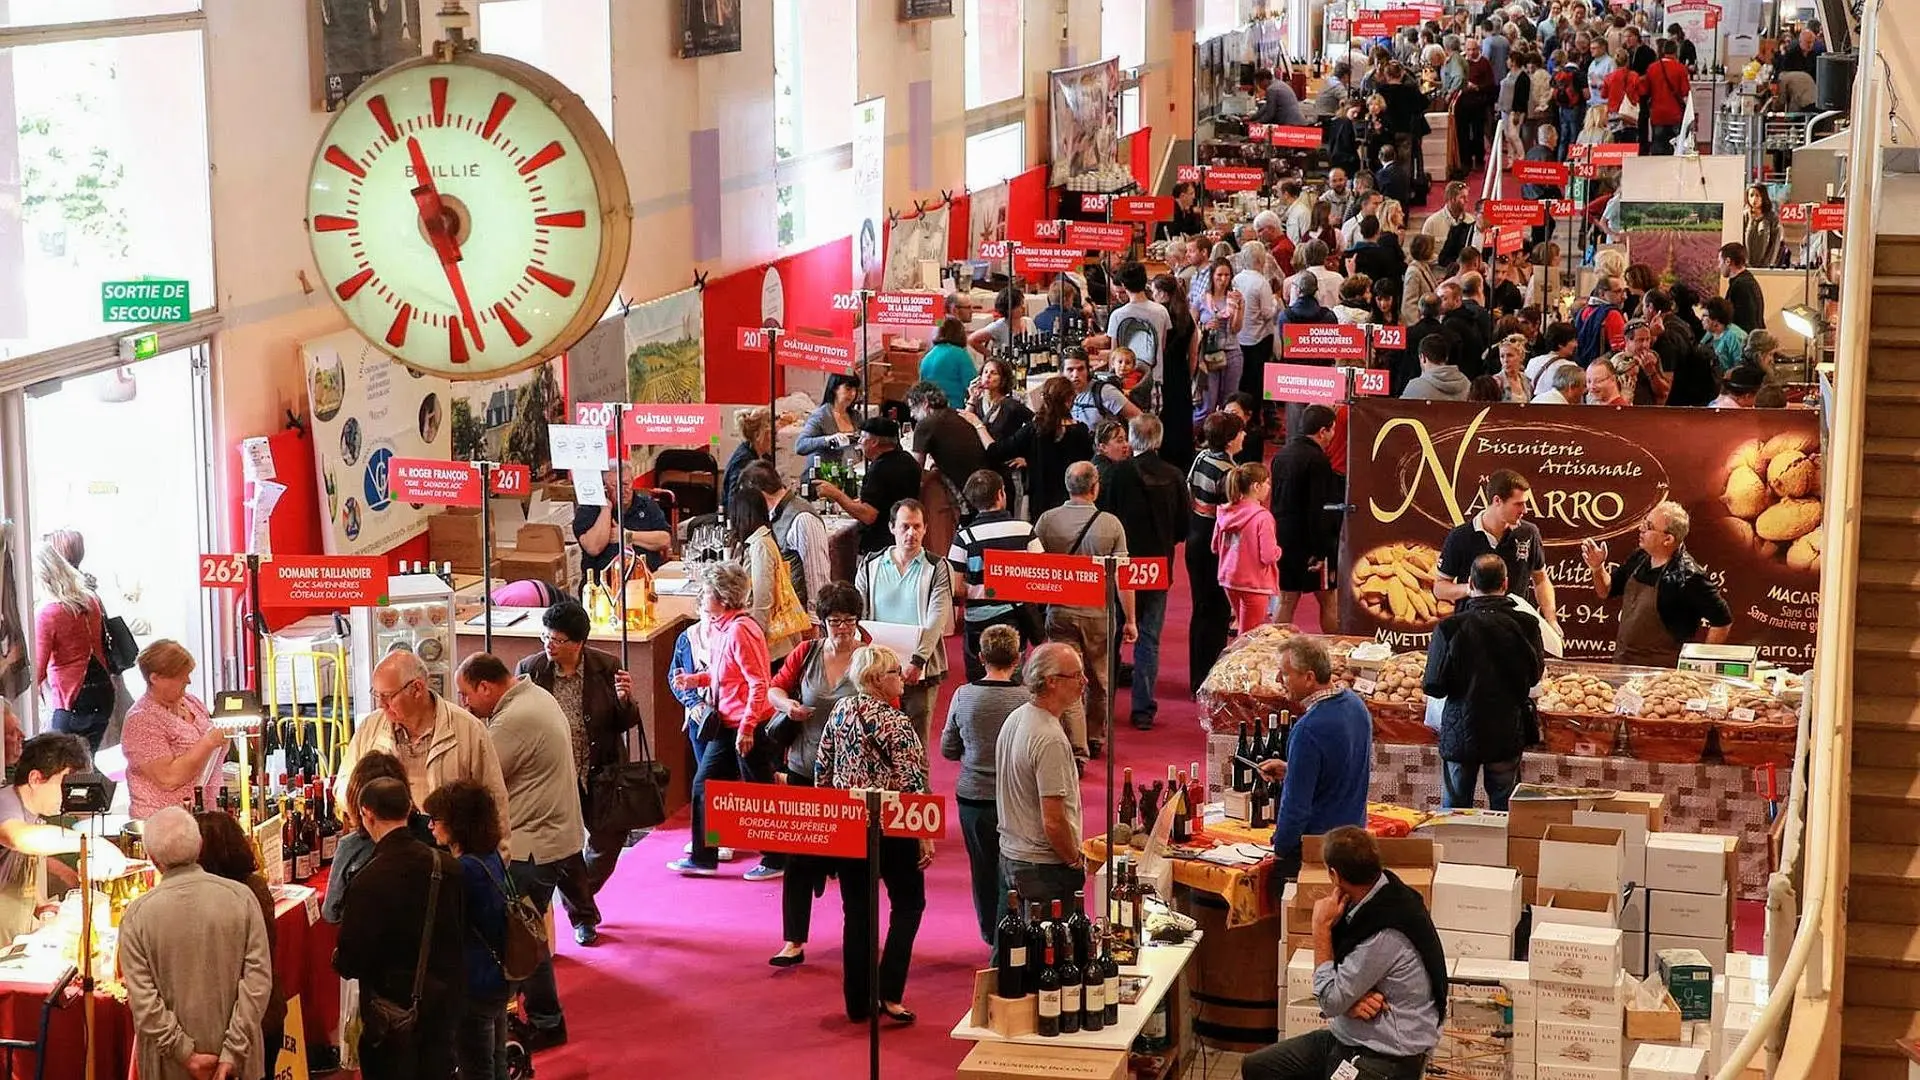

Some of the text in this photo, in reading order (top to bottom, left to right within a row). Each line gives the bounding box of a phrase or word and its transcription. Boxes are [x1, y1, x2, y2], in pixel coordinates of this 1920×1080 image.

[1249, 126, 1266, 137] 207
[405, 163, 481, 178] BILLIÉ
[1179, 168, 1198, 179] 206
[1579, 165, 1593, 176] 243
[1084, 198, 1105, 209] 205
[1491, 203, 1514, 211] CHÂTEAU
[1555, 202, 1571, 214] 244
[1782, 206, 1804, 220] 245
[1036, 223, 1057, 236] 204
[1074, 225, 1098, 234] DOMAINE
[1098, 226, 1107, 235] DES
[981, 243, 1004, 257] 203
[1015, 247, 1039, 256] CHÂTEAU
[1039, 248, 1053, 256] TOUR
[104, 284, 185, 299] SORTIE DE
[833, 294, 858, 310] 202
[877, 294, 933, 305] CHÂTEAU LES SOURCES
[109, 305, 181, 320] SECOURS
[1309, 328, 1340, 336] DOMAINE
[1380, 330, 1401, 345] 252
[743, 331, 761, 347] 201
[783, 339, 813, 352] CHÂTEAU
[1298, 336, 1353, 345] DES FOURQUIÈRES
[821, 356, 852, 366] BOURGOGNE
[1277, 375, 1335, 388] BISCUITERIE NAVARRO
[1361, 373, 1384, 391] 253
[579, 407, 610, 426] 200
[635, 412, 705, 424] CHÂTEAU VALGUY
[1477, 437, 1584, 456] Biscuiterie
[398, 468, 469, 481] M. ROGER FRANÇOIS
[1538, 459, 1643, 477] Artisanale
[423, 481, 450, 489] CALVADOS
[497, 470, 520, 489] 261
[442, 490, 458, 498] POIRE
[202, 558, 244, 583] 262
[279, 567, 372, 579] DOMAINE TAILLANDIER
[990, 564, 1099, 583] LES PROMESSES DE LA TERRE
[1128, 562, 1160, 585] 259
[292, 580, 360, 589] AOC SAVENNIÈRES
[1025, 581, 1064, 592] CORBIÈRES
[290, 590, 364, 599] CÔTEAUX DU LAYON
[1576, 604, 1609, 624] 94
[1747, 605, 1768, 623] Sans
[1768, 616, 1807, 631] matière
[1781, 605, 1802, 618] Sans
[712, 792, 864, 821] CHÂTEAU LA TUILERIE DU PUY
[889, 802, 941, 832] 260
[739, 817, 838, 833] BORDEAUX SUPÉRIEUR
[747, 829, 829, 844] ENTRE-DEUX-MERS
[1554, 944, 1589, 953] CHATEAU
[1562, 986, 1596, 994] CHATEAU
